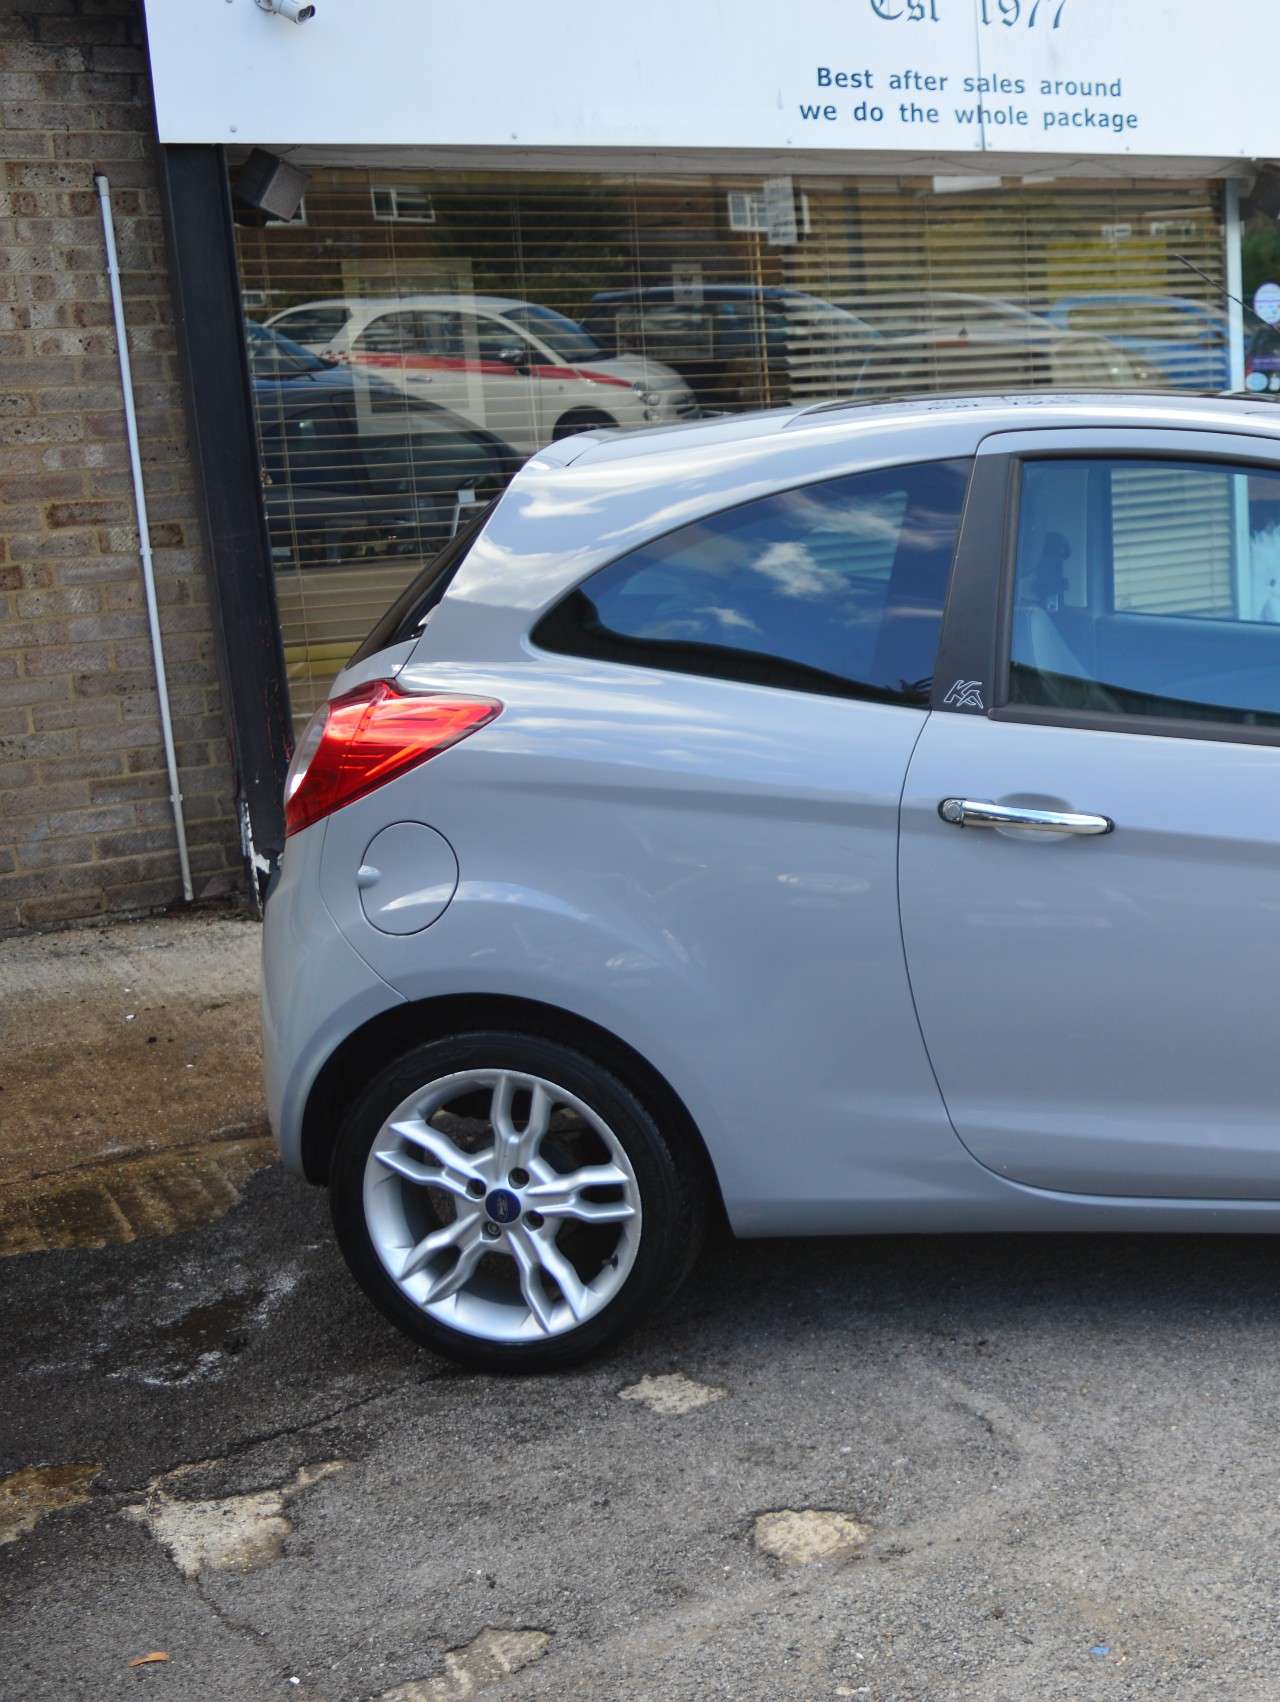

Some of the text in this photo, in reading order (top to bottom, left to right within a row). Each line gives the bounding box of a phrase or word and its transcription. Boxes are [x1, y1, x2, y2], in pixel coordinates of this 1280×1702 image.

[816, 66, 1122, 98] Best after sales around
[799, 101, 1139, 133] we do the whole package
